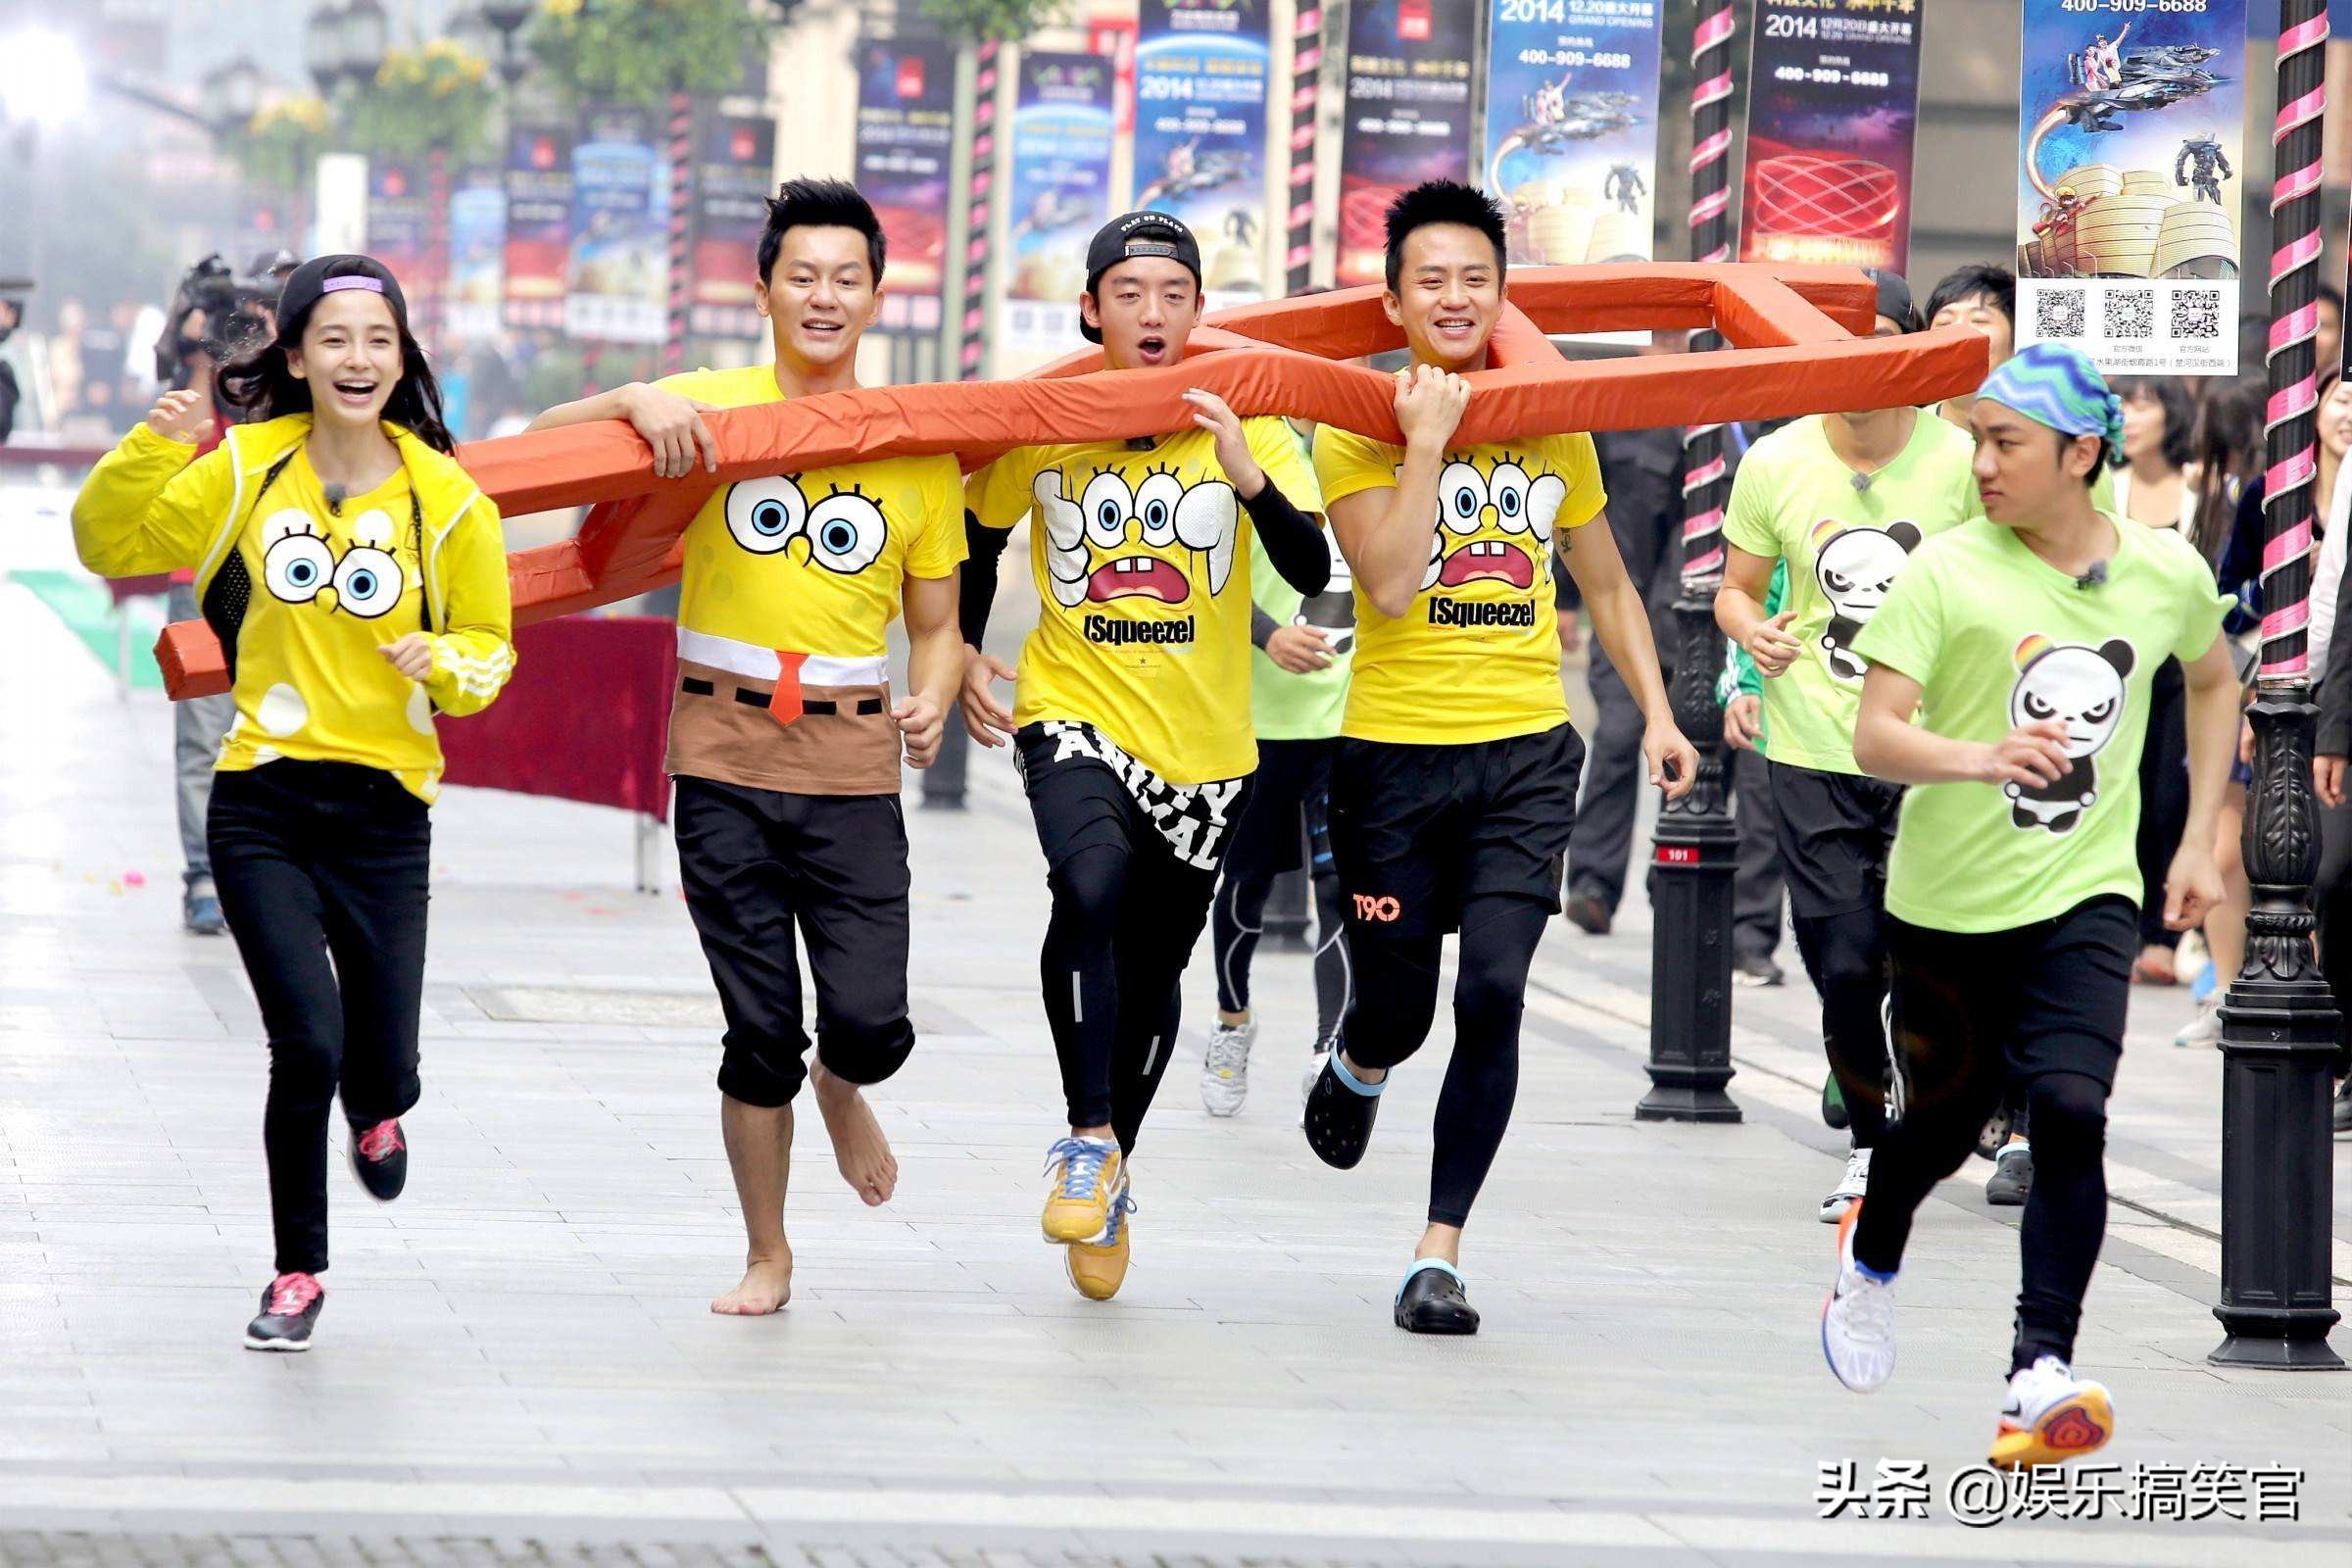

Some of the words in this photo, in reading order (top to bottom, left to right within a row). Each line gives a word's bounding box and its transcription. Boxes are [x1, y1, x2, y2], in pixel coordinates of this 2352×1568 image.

[1500, 0, 1565, 24] 2014
[2061, 0, 2207, 12] 400-909-6688
[1765, 14, 1817, 38] 2014
[1518, 49, 1631, 69] 400-909-6688
[1775, 66, 1888, 86] 400-909-6688
